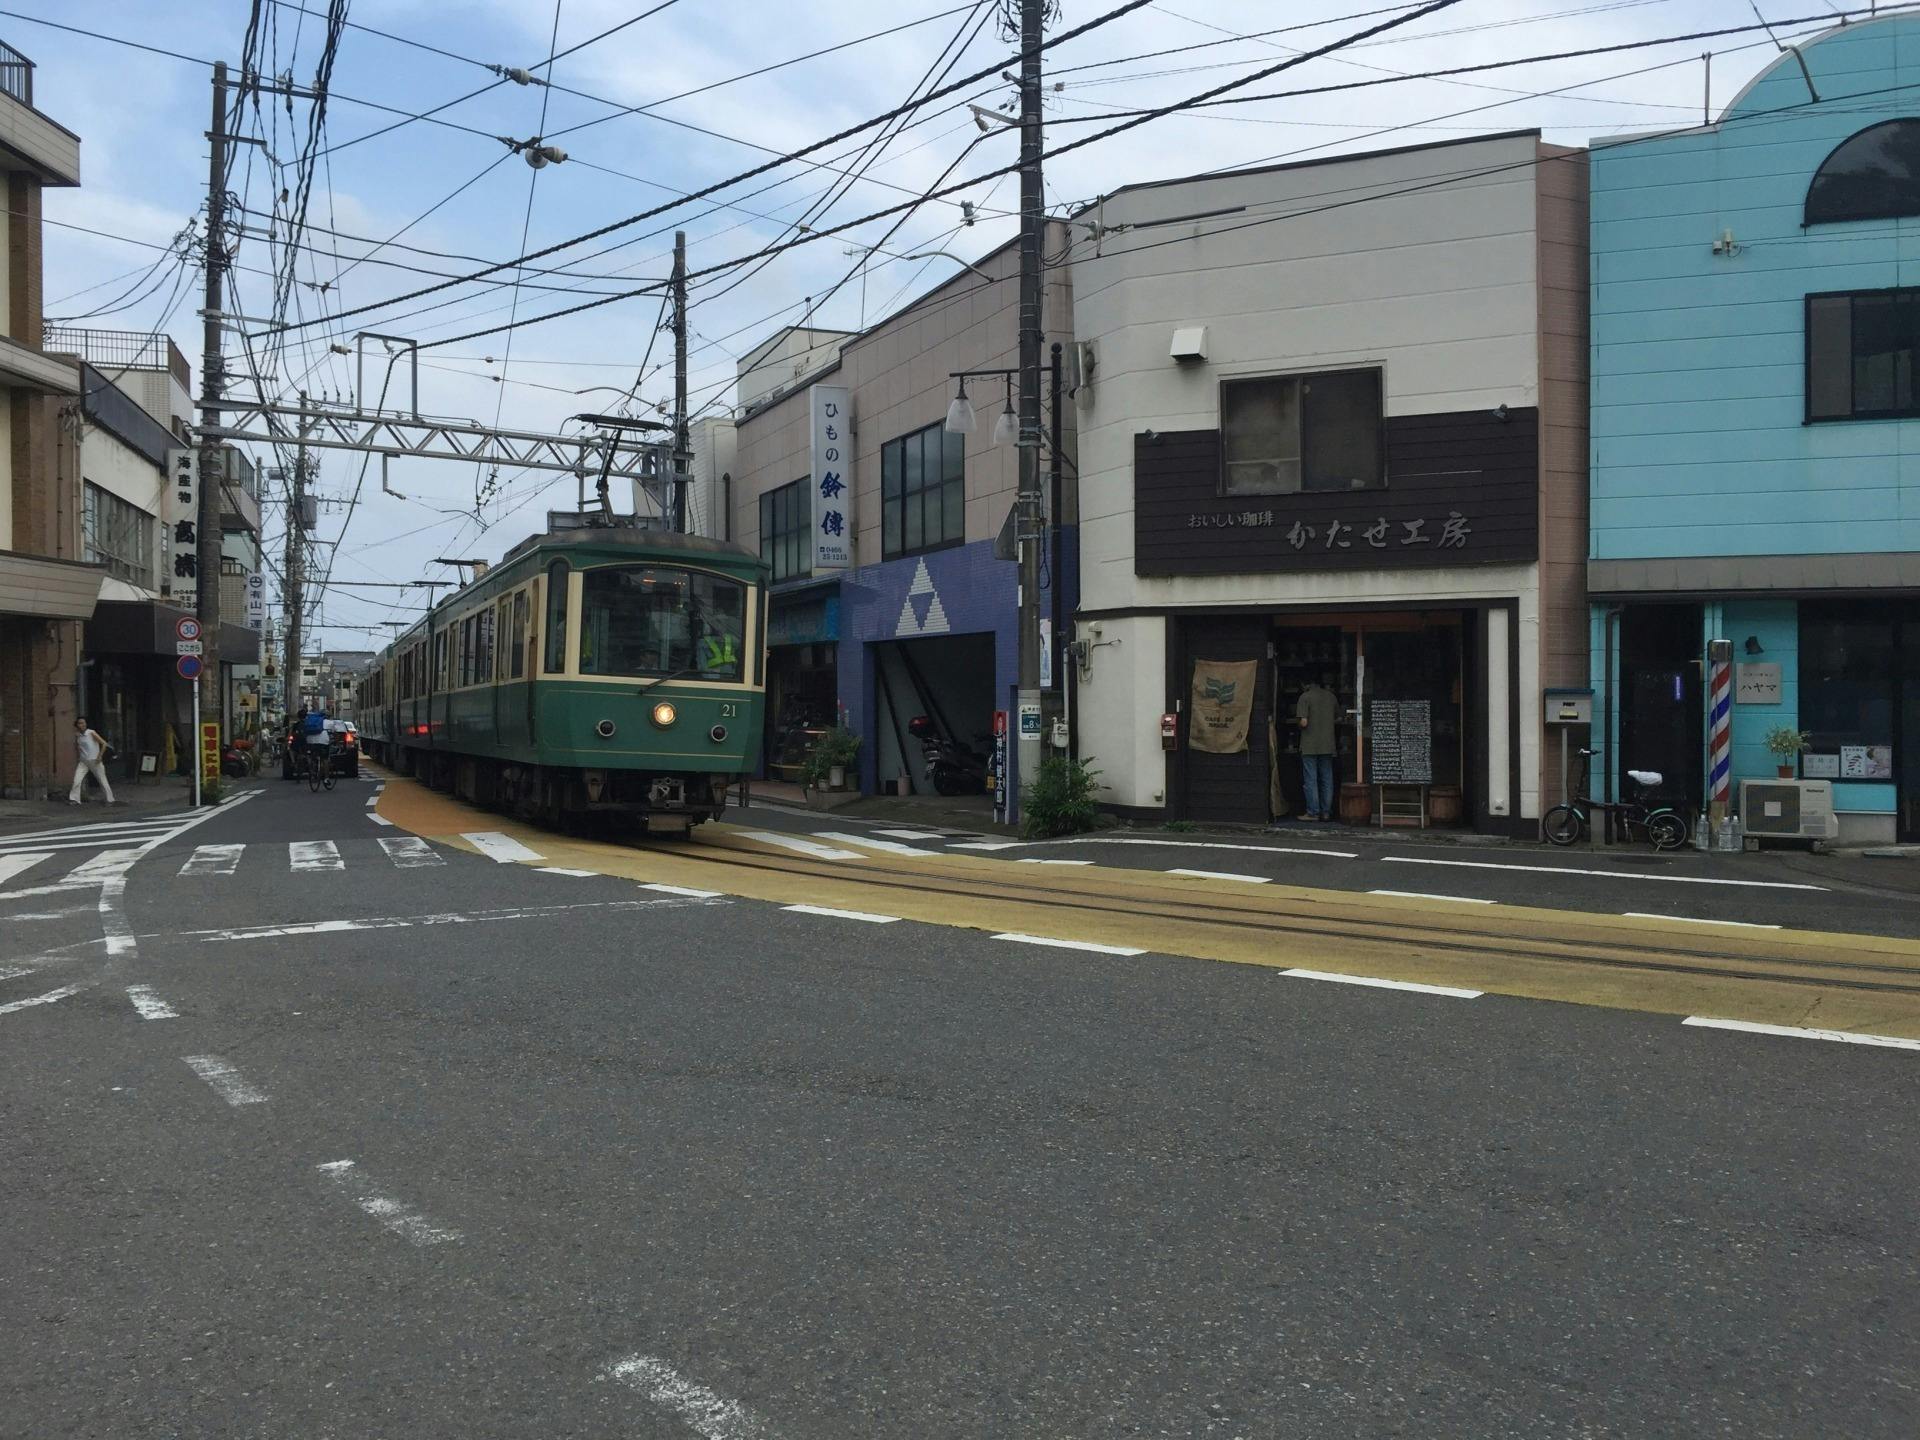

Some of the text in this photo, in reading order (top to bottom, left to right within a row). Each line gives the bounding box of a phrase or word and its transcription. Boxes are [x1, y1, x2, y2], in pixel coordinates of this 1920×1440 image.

[824, 402, 839, 463] ひもの
[1187, 510, 1472, 550] おいしい珈琲 かたせ工房
[183, 624, 196, 635] 30
[722, 704, 736, 717] 21
